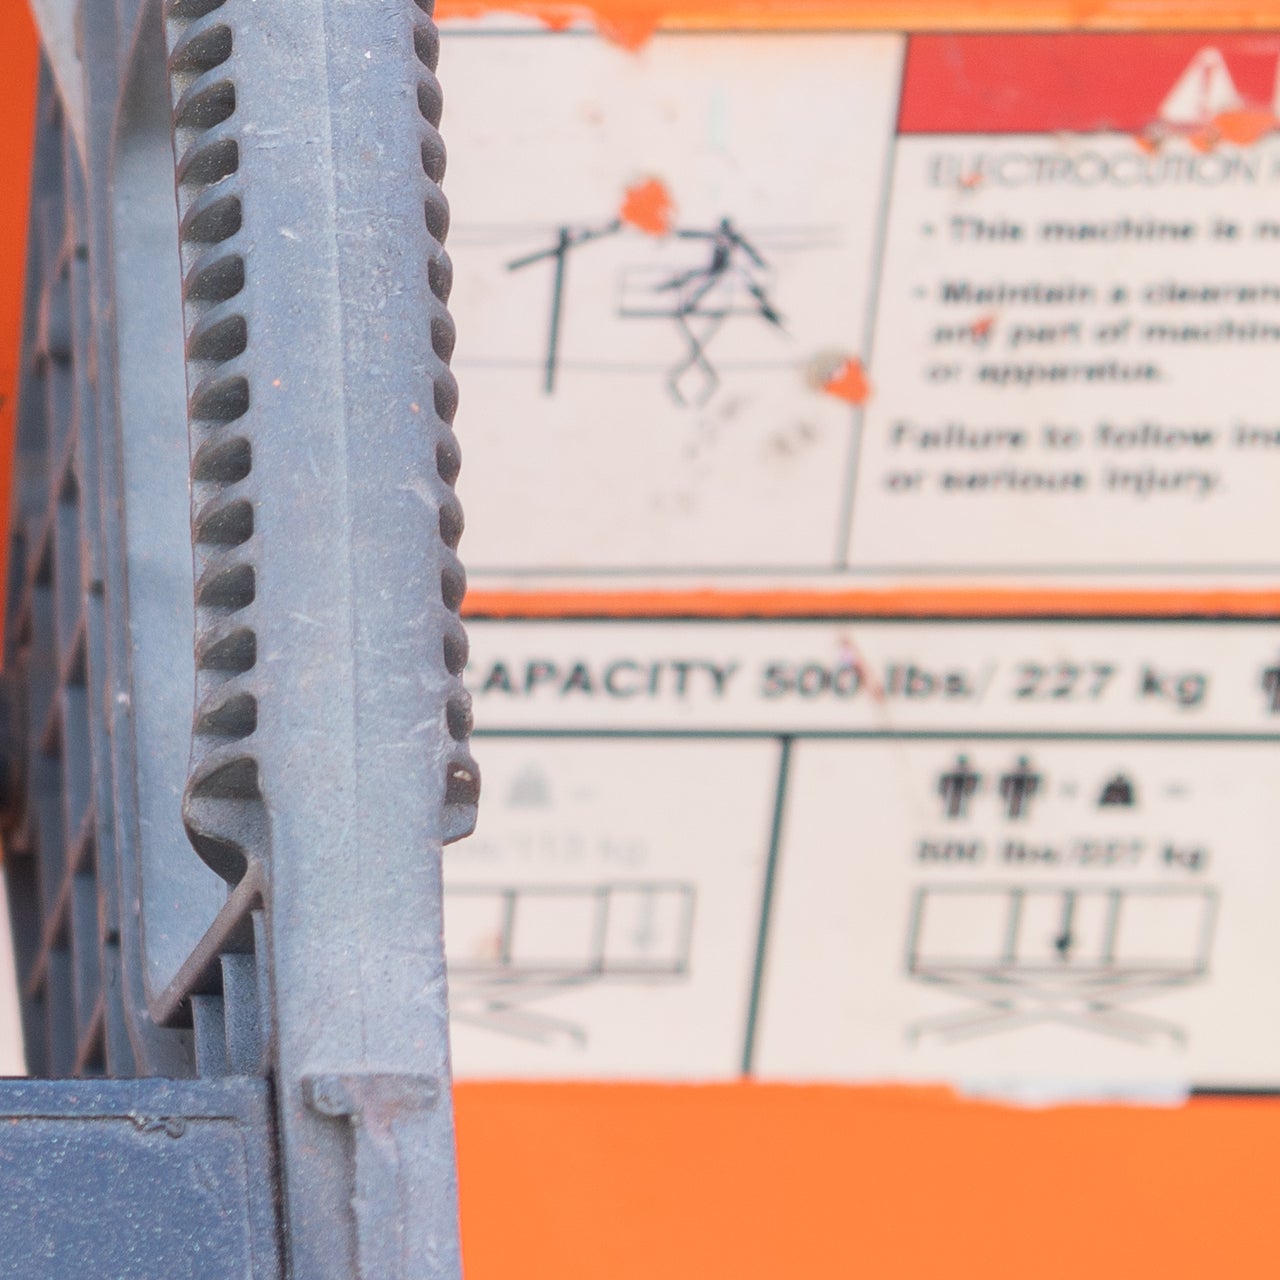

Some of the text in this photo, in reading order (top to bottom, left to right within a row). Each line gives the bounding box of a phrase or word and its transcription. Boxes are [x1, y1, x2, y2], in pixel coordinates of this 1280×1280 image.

[1145, 320, 1280, 343] machin
[467, 660, 742, 698] APACITY
[761, 661, 866, 698] 500
[1013, 661, 1116, 699] 227
[1140, 660, 1208, 708] kg
